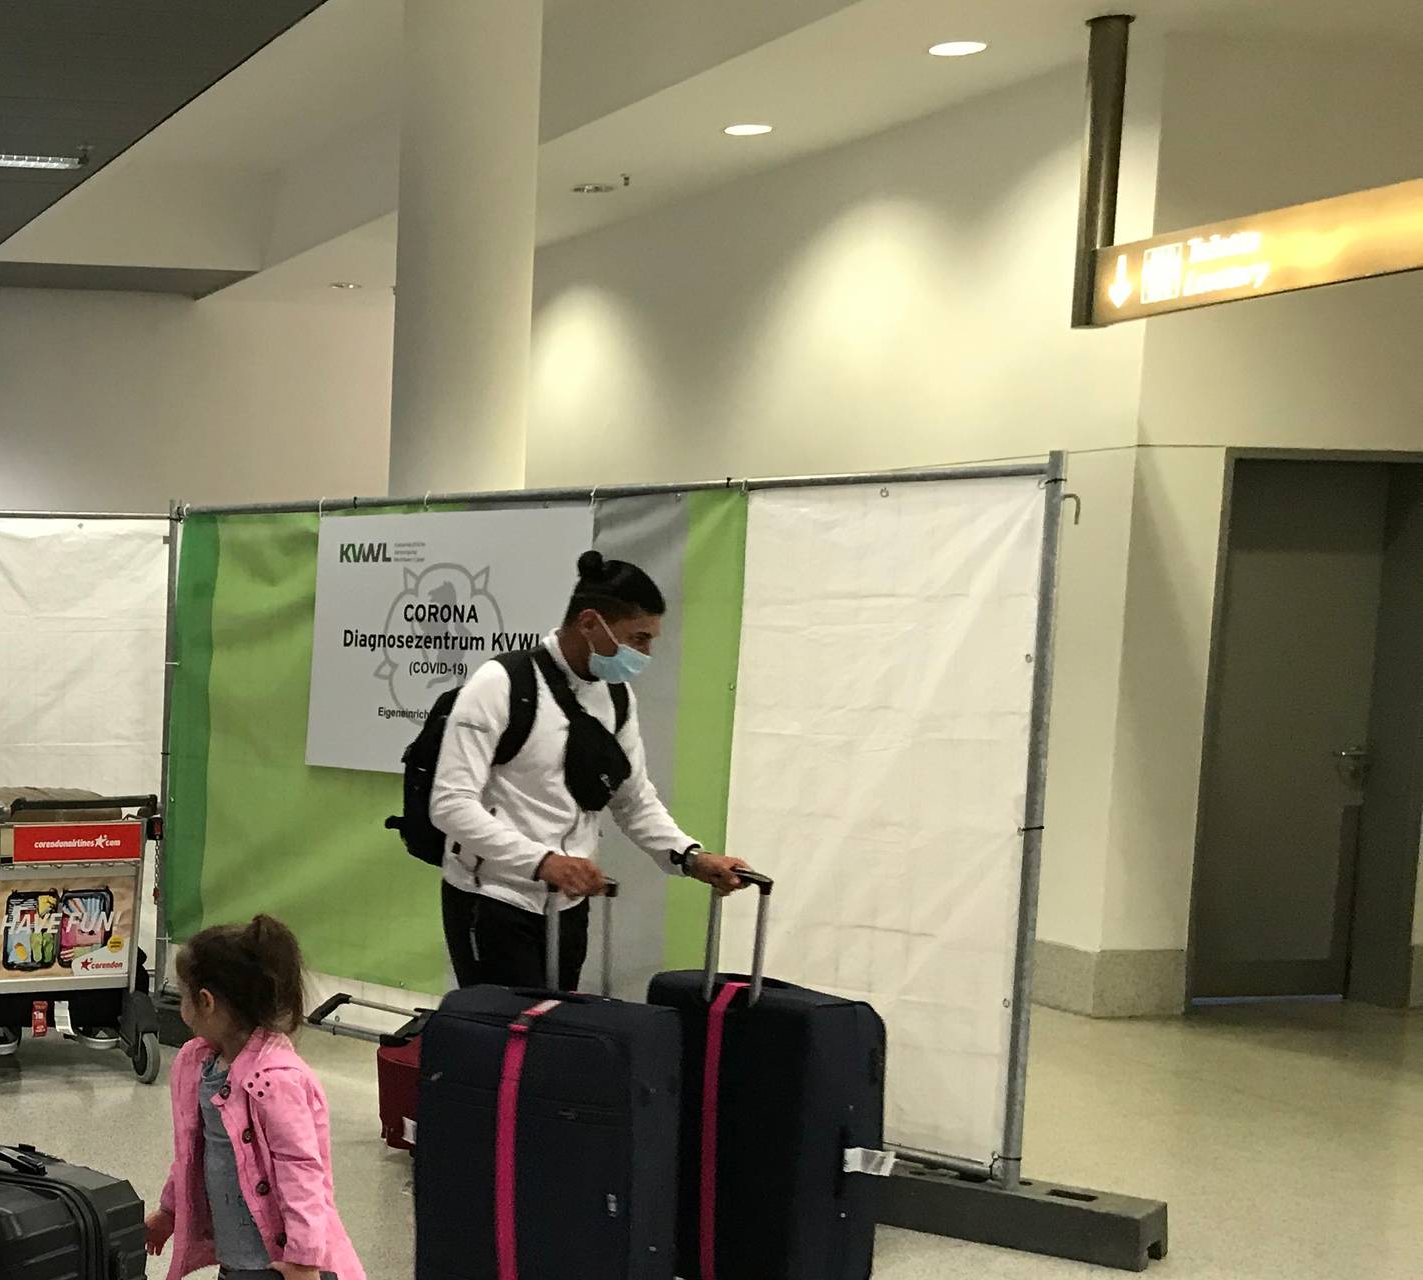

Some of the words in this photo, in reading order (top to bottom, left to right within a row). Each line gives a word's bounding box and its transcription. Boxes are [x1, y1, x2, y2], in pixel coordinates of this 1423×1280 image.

[339, 542, 392, 563] KVWL
[403, 604, 479, 624] CORONA
[343, 629, 485, 652] Diagnosezentrum
[408, 661, 469, 679] (COVID-19)
[378, 706, 431, 720] Eigeneinrich
[1, 912, 64, 935] HAVE
[90, 960, 123, 970] corendon
